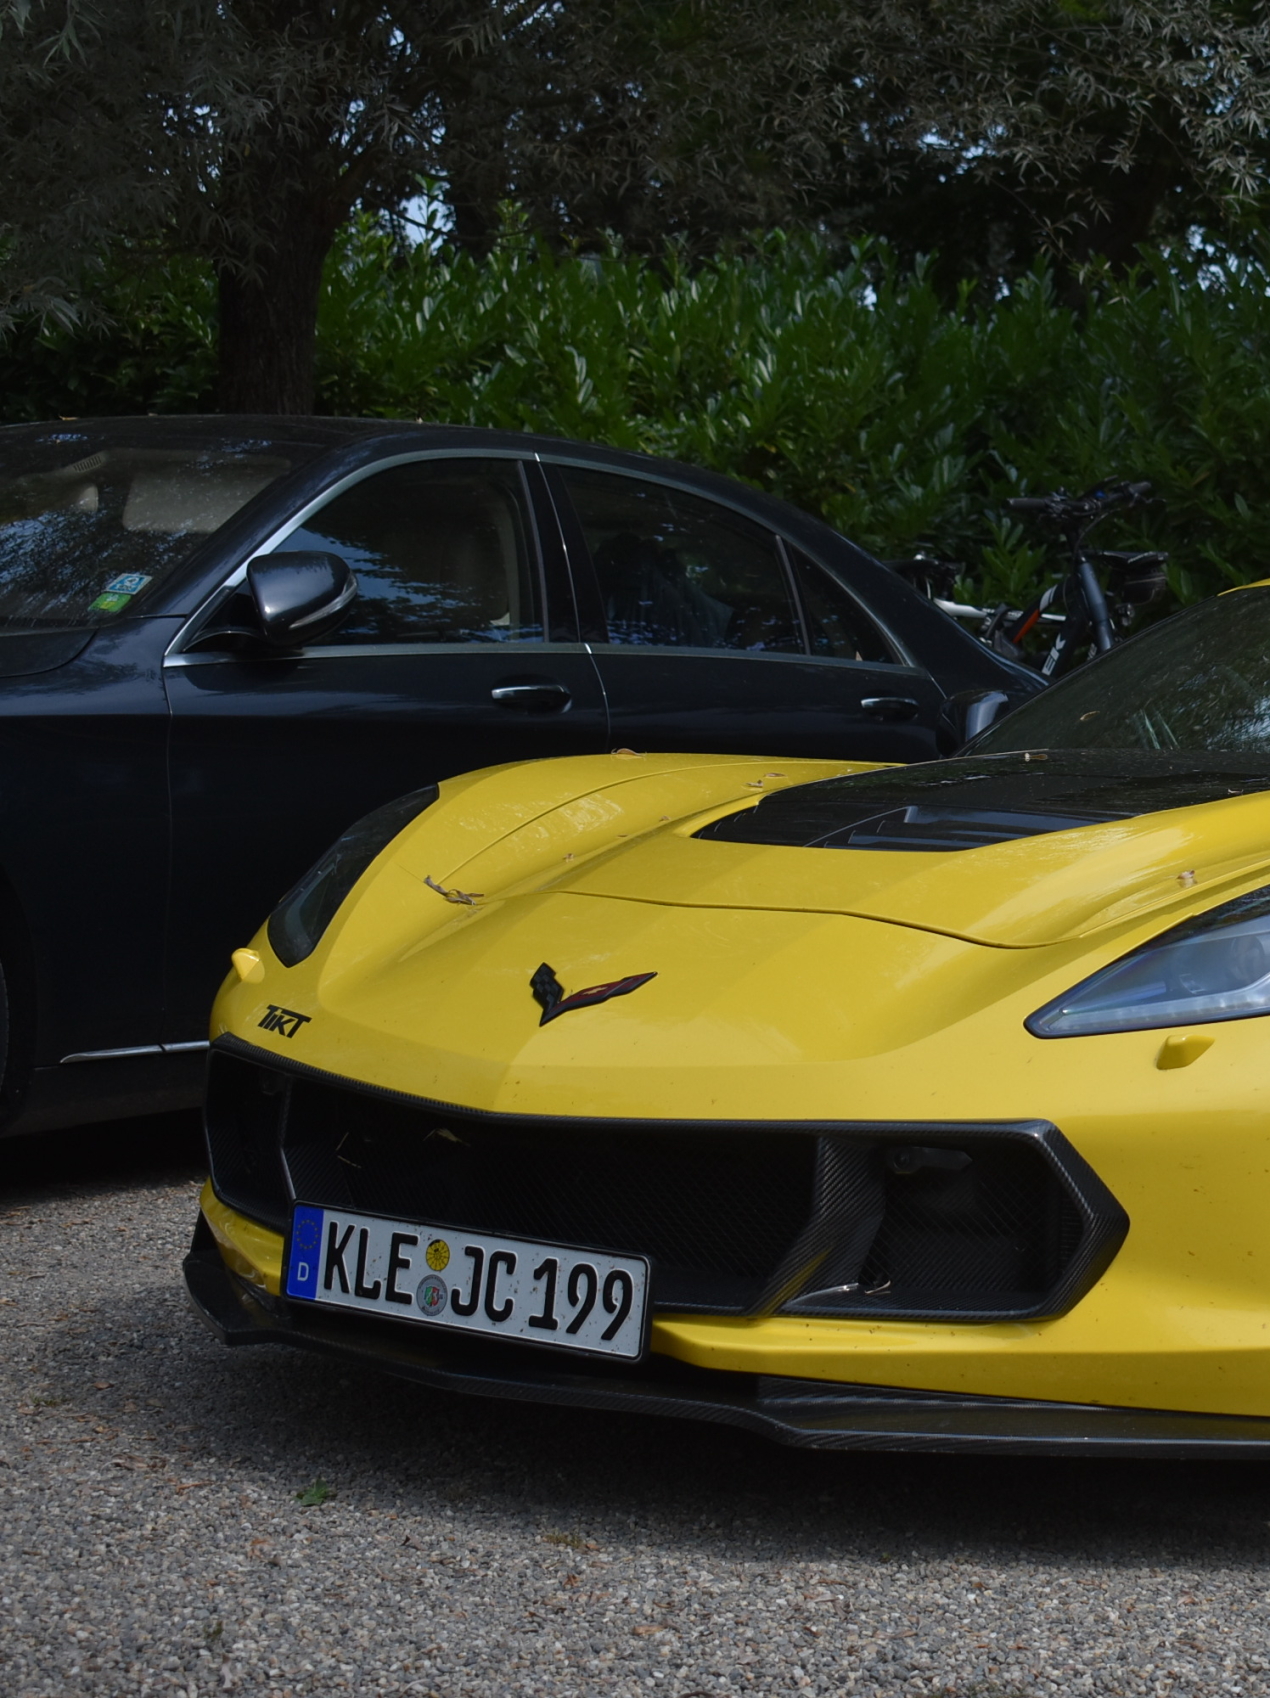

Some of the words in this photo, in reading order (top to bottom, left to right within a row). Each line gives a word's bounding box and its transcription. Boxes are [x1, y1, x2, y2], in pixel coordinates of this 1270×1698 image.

[297, 1261, 309, 1281] D
[323, 1221, 419, 1305] KLE
[450, 1245, 517, 1322] JC
[528, 1257, 634, 1341] 199
